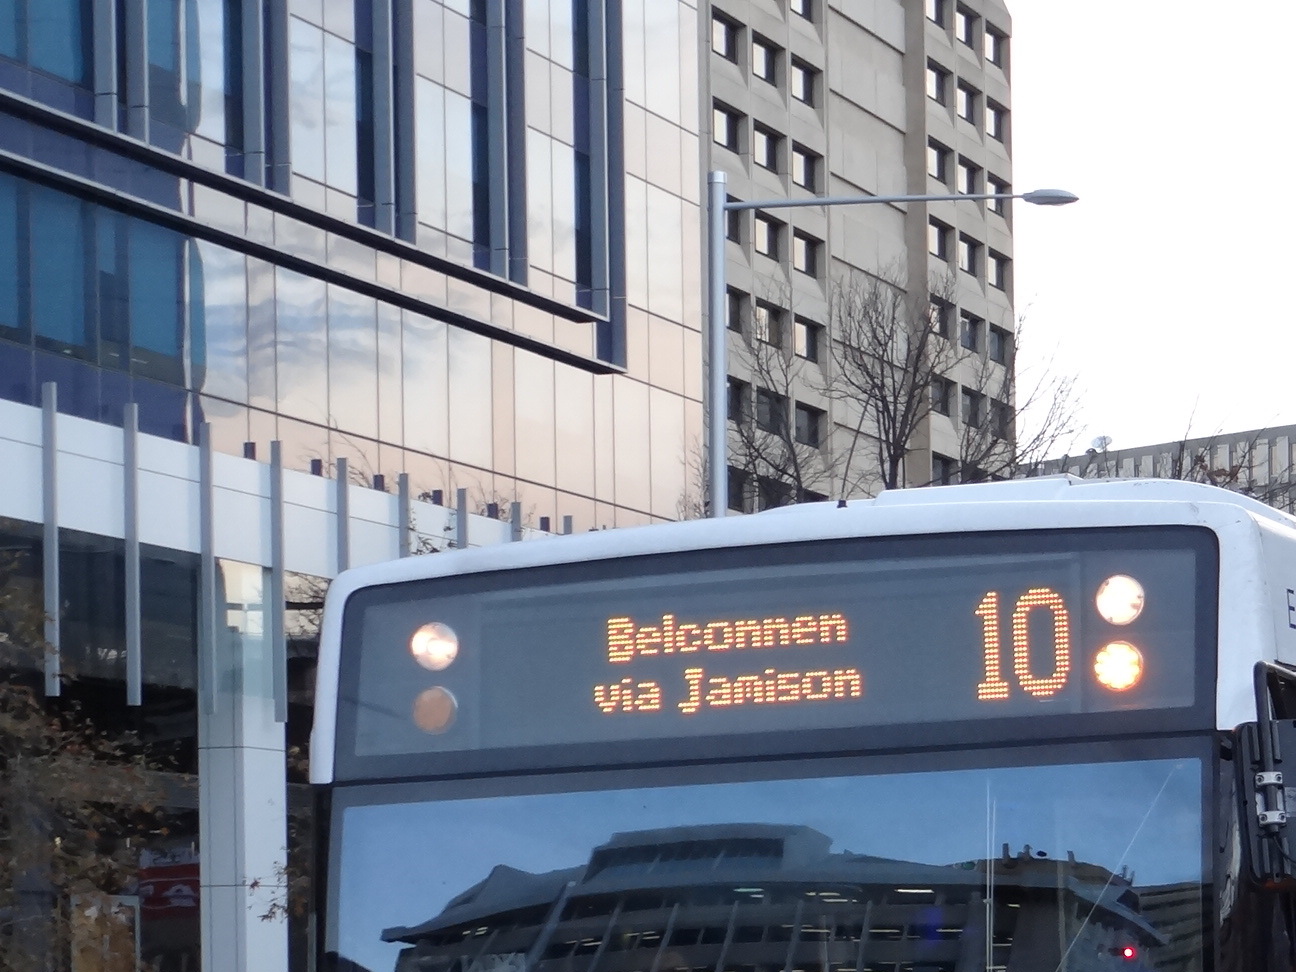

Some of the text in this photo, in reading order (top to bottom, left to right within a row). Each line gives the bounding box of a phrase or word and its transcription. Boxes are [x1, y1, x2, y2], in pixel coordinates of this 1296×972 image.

[606, 611, 849, 663] Belconnen
[975, 587, 1069, 700] 10
[594, 666, 864, 714] via Jamison
